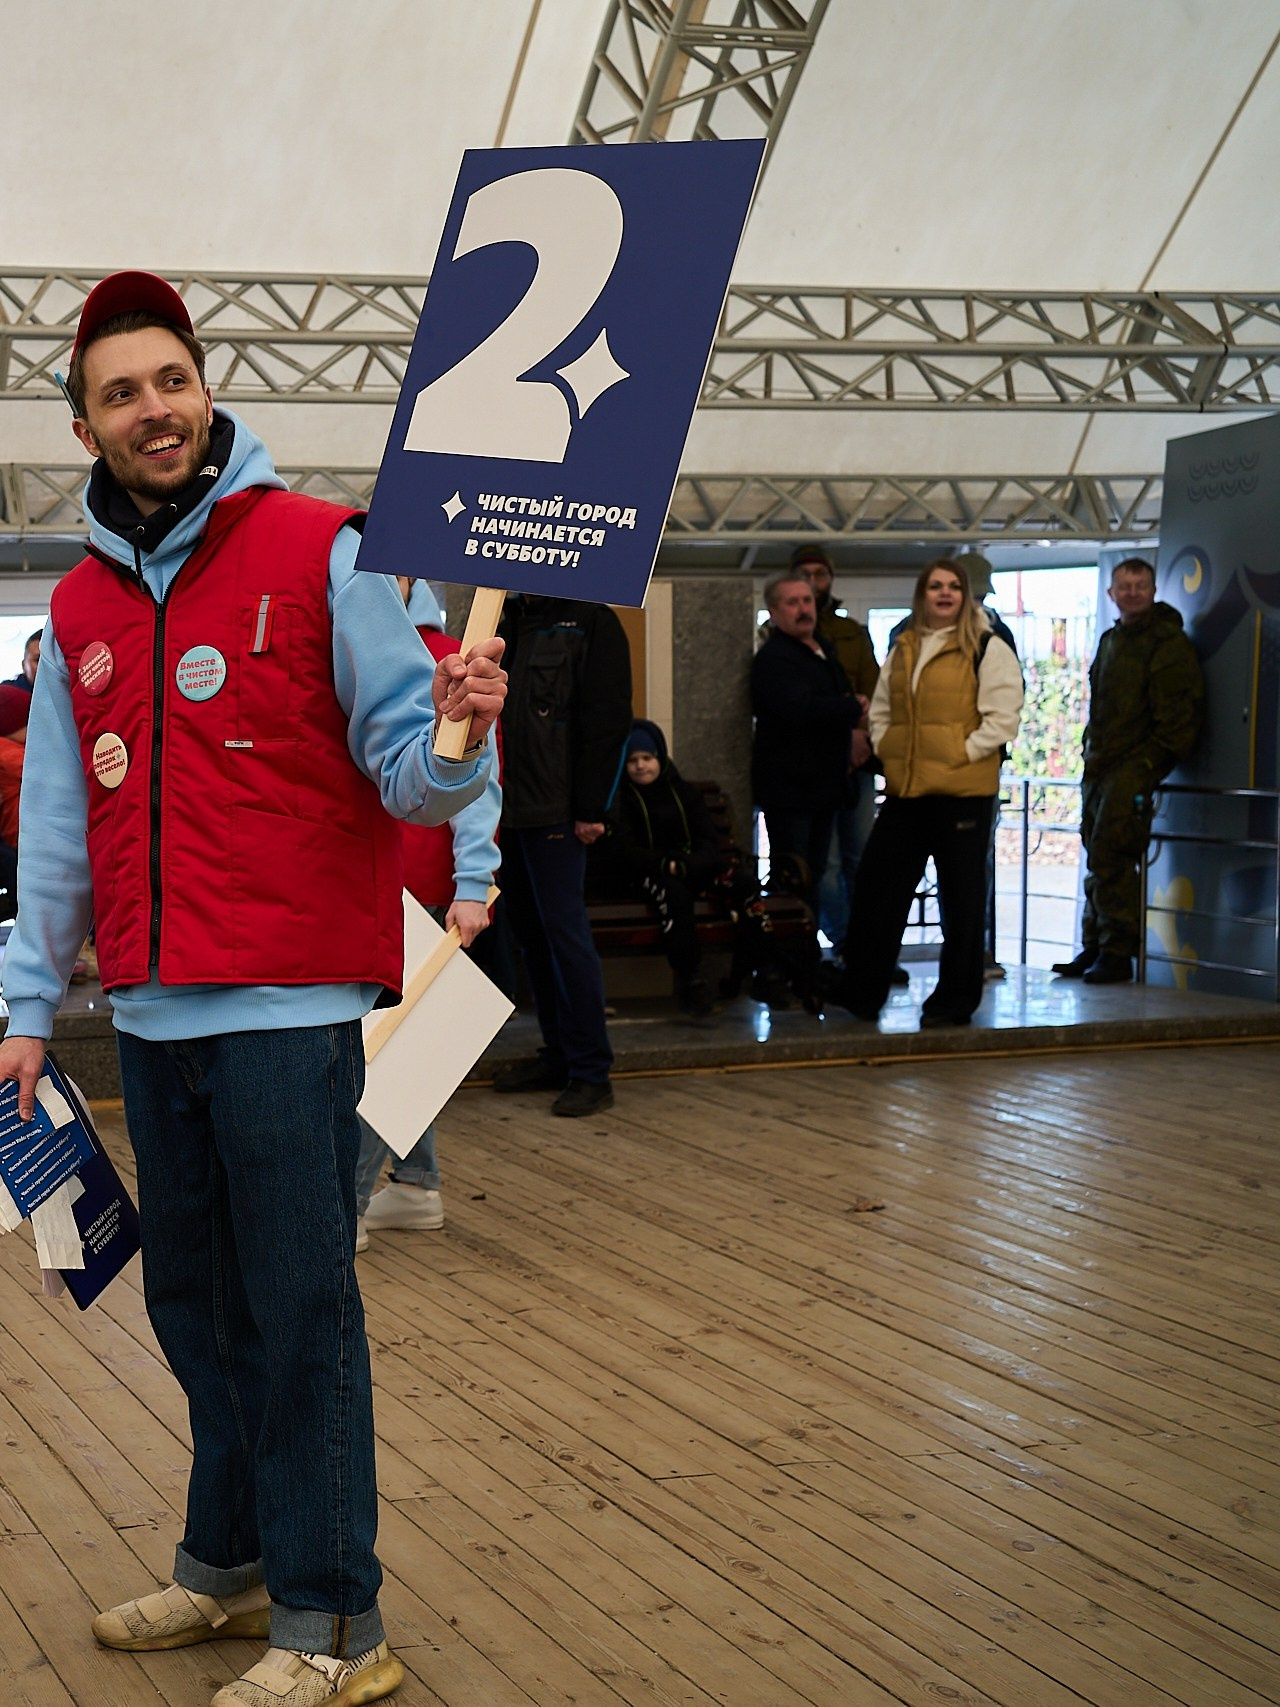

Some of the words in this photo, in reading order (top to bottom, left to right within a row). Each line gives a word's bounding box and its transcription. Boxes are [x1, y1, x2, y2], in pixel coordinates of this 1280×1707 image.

[403, 167, 624, 463] 2
[477, 493, 565, 518] ЧИСТЫЙ
[566, 503, 638, 530] ГОРОД
[470, 516, 607, 547] НАЧИНАЕТСЯ
[464, 538, 479, 556] В
[481, 541, 581, 568] СУББОТУ!
[91, 652, 111, 672] чистой
[180, 658, 216, 670] Вместе
[186, 668, 223, 679] чистом
[184, 677, 217, 690] месте!
[95, 745, 122, 760] Наводить
[105, 758, 126, 773] весело!
[84, 1213, 106, 1237] ЧИСТЫЙ
[104, 1198, 122, 1218] ГОРОД
[88, 1212, 120, 1246] НАЧИНАЕТСЯ
[97, 1224, 120, 1250] СУББОТУ!
